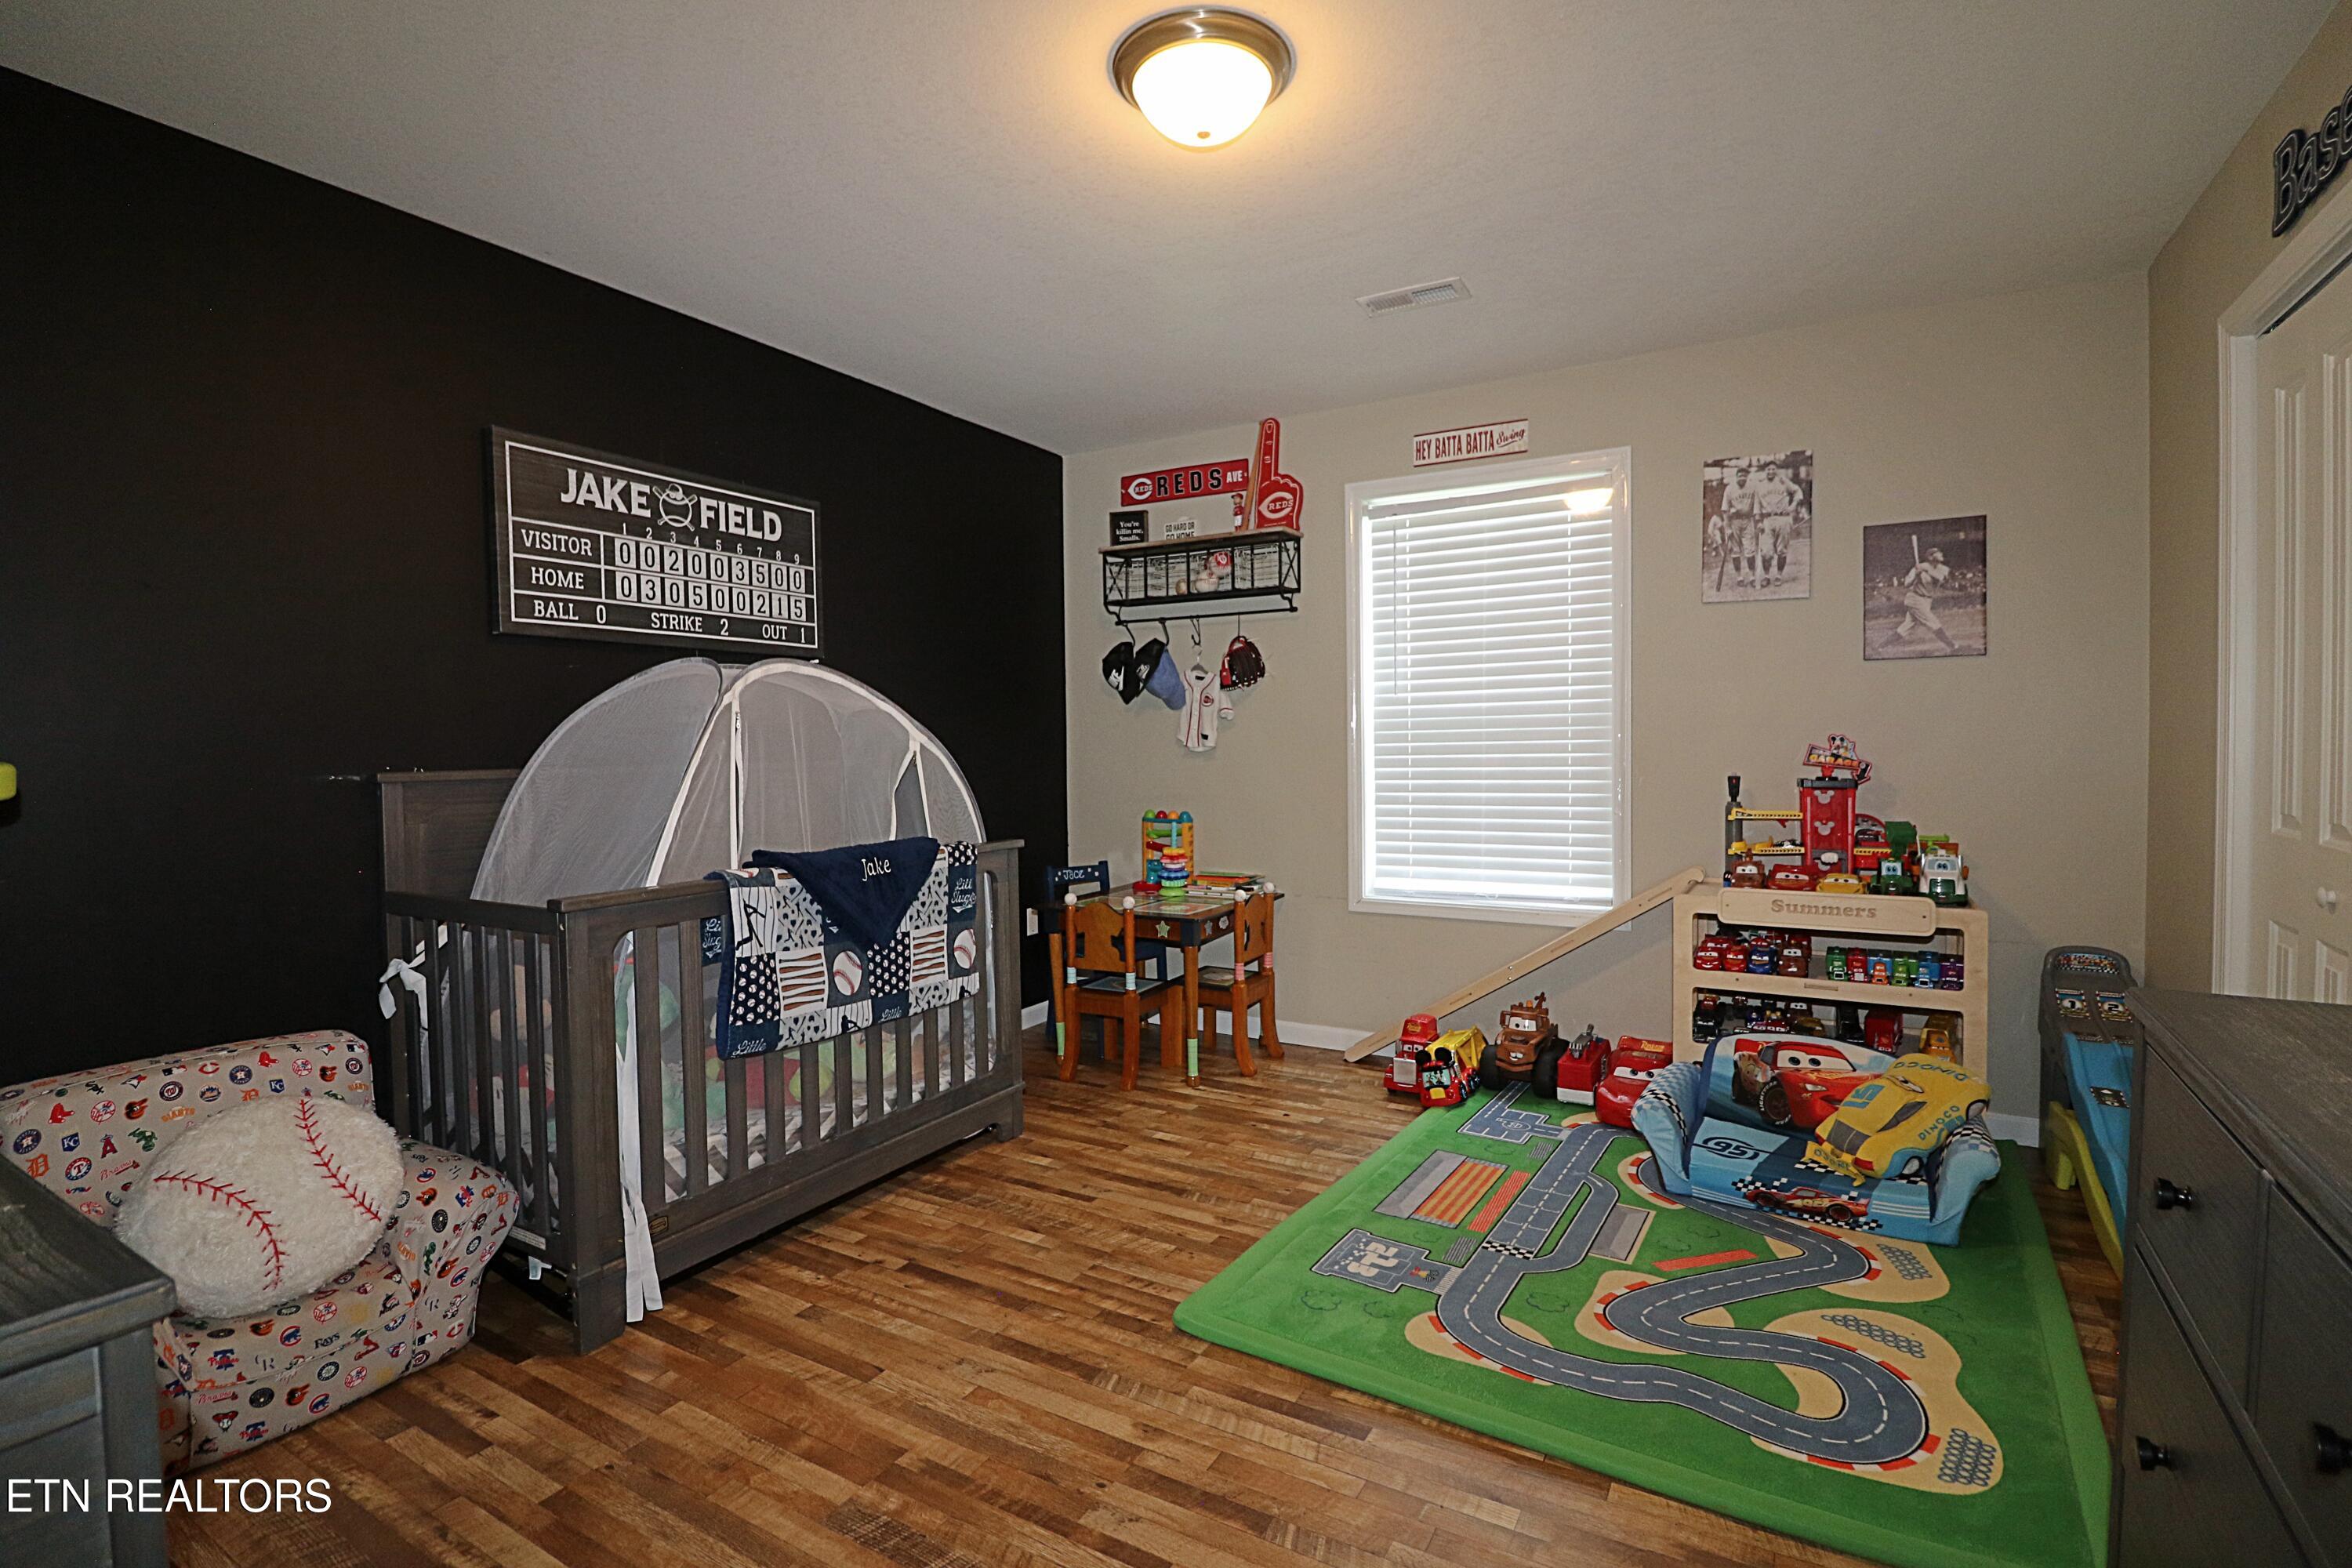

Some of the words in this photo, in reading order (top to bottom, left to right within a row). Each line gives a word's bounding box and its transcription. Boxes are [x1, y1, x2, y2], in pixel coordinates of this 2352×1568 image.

[1415, 438, 1432, 461] HEY
[1435, 434, 1462, 458] BATTA
[1466, 430, 1494, 454] BATTA
[1496, 428, 1526, 445] Swing
[1156, 468, 1222, 497] REDS
[1226, 470, 1243, 483] AVE
[561, 467, 652, 518] JAKE
[699, 496, 782, 542] FIELD
[1269, 498, 1294, 510] REDS
[622, 522, 626, 535] 1
[646, 527, 652, 539] 2
[670, 532, 677, 543] 3
[694, 535, 700, 547] 4
[716, 539, 722, 551] 5
[737, 543, 743, 555] 6
[757, 547, 763, 558] 7
[775, 550, 782, 561] 8
[793, 554, 800, 564] 9
[521, 528, 593, 557] VISITOR
[619, 543, 631, 564] 0
[644, 546, 655, 568] 0
[669, 550, 679, 572] 2
[691, 554, 702, 575] 0
[714, 557, 724, 578] 0
[735, 561, 745, 581] 3
[756, 564, 765, 583] 5
[775, 568, 784, 586] 0
[793, 571, 802, 590] 0
[531, 566, 585, 590] HOME
[620, 576, 632, 597] 0
[645, 579, 656, 601] 3
[670, 583, 681, 603] 0
[692, 585, 703, 606] 5
[715, 589, 725, 608] 0
[736, 591, 746, 612] 0
[757, 594, 766, 613] 2
[777, 597, 782, 616] 1
[793, 600, 803, 618] 5
[533, 600, 579, 621] BALL
[596, 604, 607, 624] 0
[651, 612, 702, 633] STRIKE
[720, 619, 729, 636] 2
[762, 624, 787, 641] OUT
[800, 627, 806, 644] 1
[861, 857, 891, 881] Jake
[1062, 869, 1085, 880] Jace
[1770, 898, 1877, 918] Summers
[2107, 1004, 2119, 1012] 2
[732, 1039, 767, 1056] Little
[1893, 1061, 1969, 1083] DINOCO
[271, 1081, 283, 1091] KC
[1918, 1105, 1961, 1142] DINOCO
[64, 1137, 79, 1149] KC
[1711, 1141, 1748, 1156] 95
